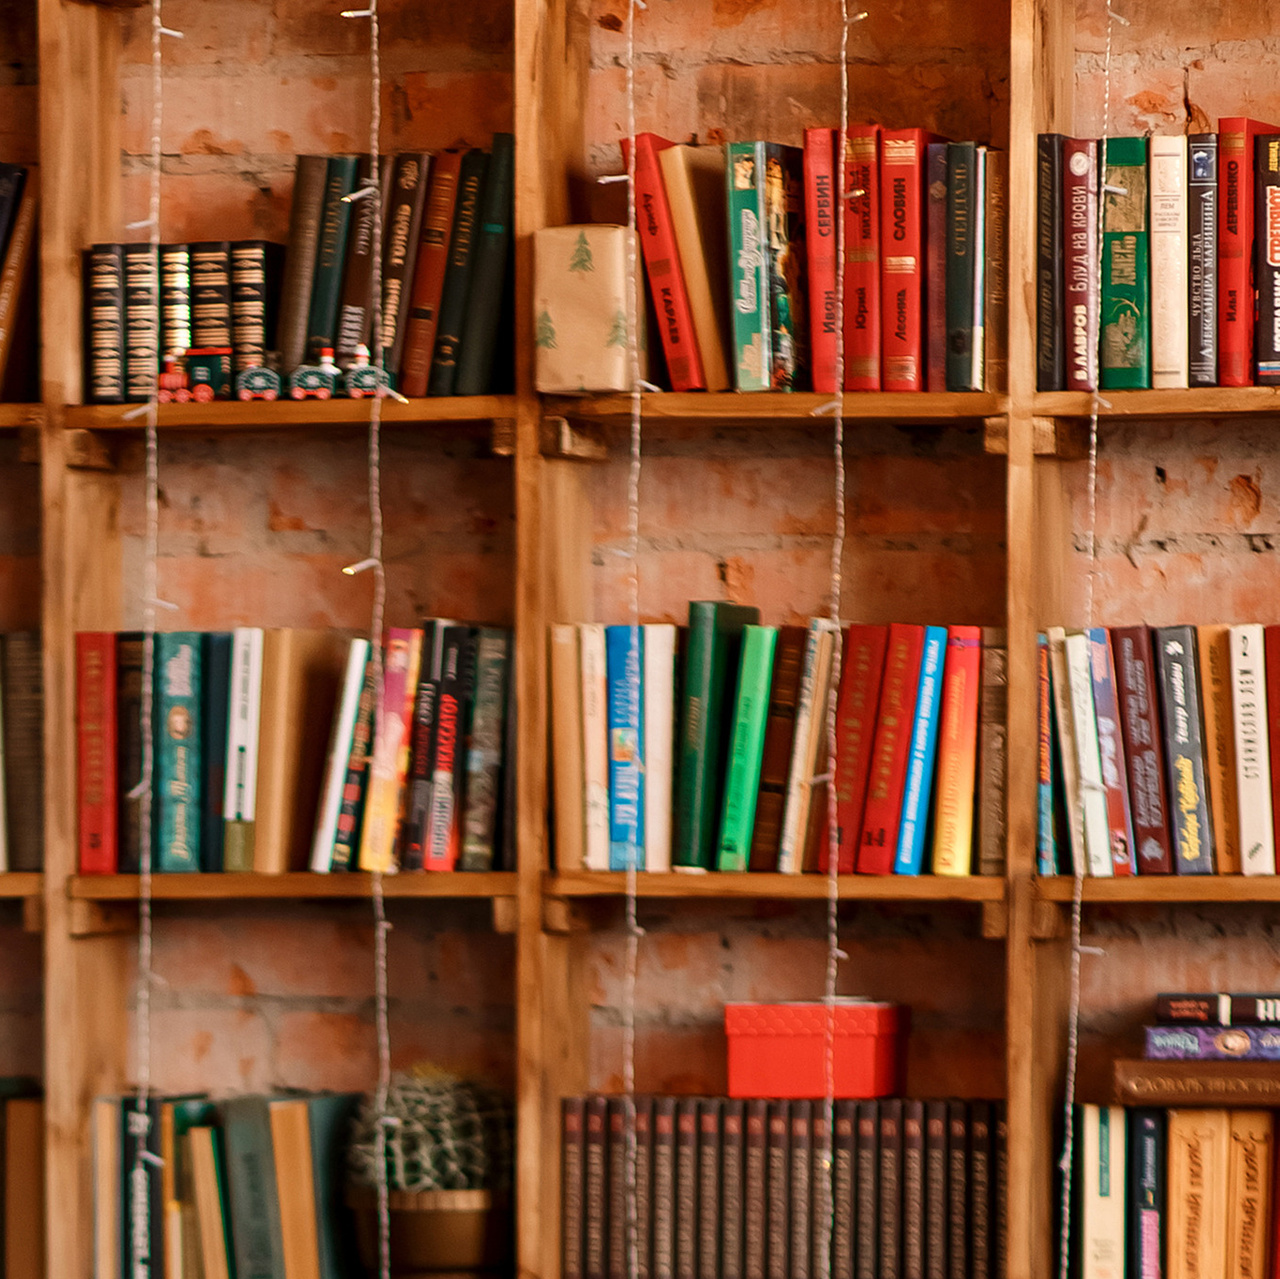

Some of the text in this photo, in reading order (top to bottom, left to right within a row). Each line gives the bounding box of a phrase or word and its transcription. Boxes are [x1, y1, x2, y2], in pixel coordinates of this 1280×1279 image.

[389, 204, 411, 266] ТОПОЛЬ
[954, 163, 969, 256] СТЕНДАЛЬ
[1071, 185, 1088, 228] крови
[1073, 232, 1088, 250] на
[1225, 160, 1239, 322] Илья ДЕРЕВЯНКО
[816, 175, 836, 334] Иван СЕРБИН
[894, 177, 907, 341] Леонид СЛОВИН
[1069, 254, 1089, 292] Блуд
[1111, 235, 1137, 286] ХМЕЛЬ
[1192, 233, 1203, 317] ЧУВСТВО ЛЬДА
[1200, 189, 1215, 359] АЛЕКСАНДРА МАРИНИНА
[660, 285, 685, 345] КАРАЕВ
[855, 287, 869, 330] Юрий
[1237, 667, 1260, 780] СТАНИСЛАВ ЛЕМ
